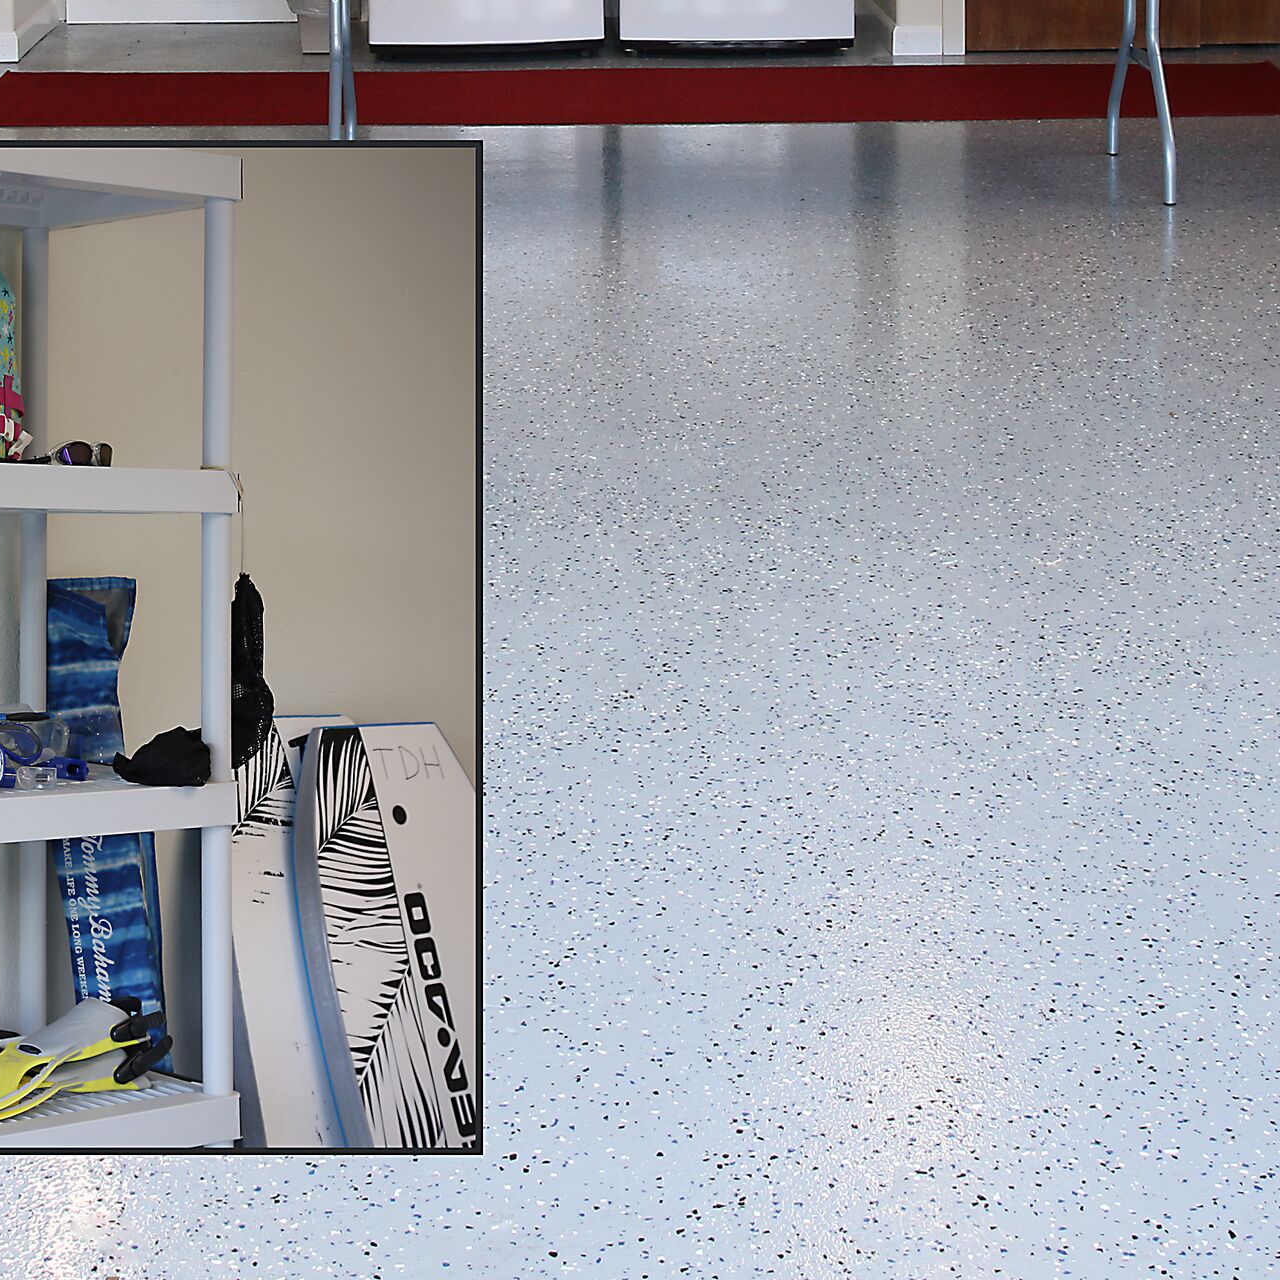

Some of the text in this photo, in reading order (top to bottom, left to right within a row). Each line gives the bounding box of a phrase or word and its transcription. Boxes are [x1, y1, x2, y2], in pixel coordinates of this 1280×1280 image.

[372, 745, 445, 780] TDH
[63, 837, 73, 868] MAKE
[66, 871, 76, 896] LIFE
[69, 899, 79, 921] ONE
[78, 835, 115, 1003] Tommy Baham
[72, 923, 83, 954] LONG
